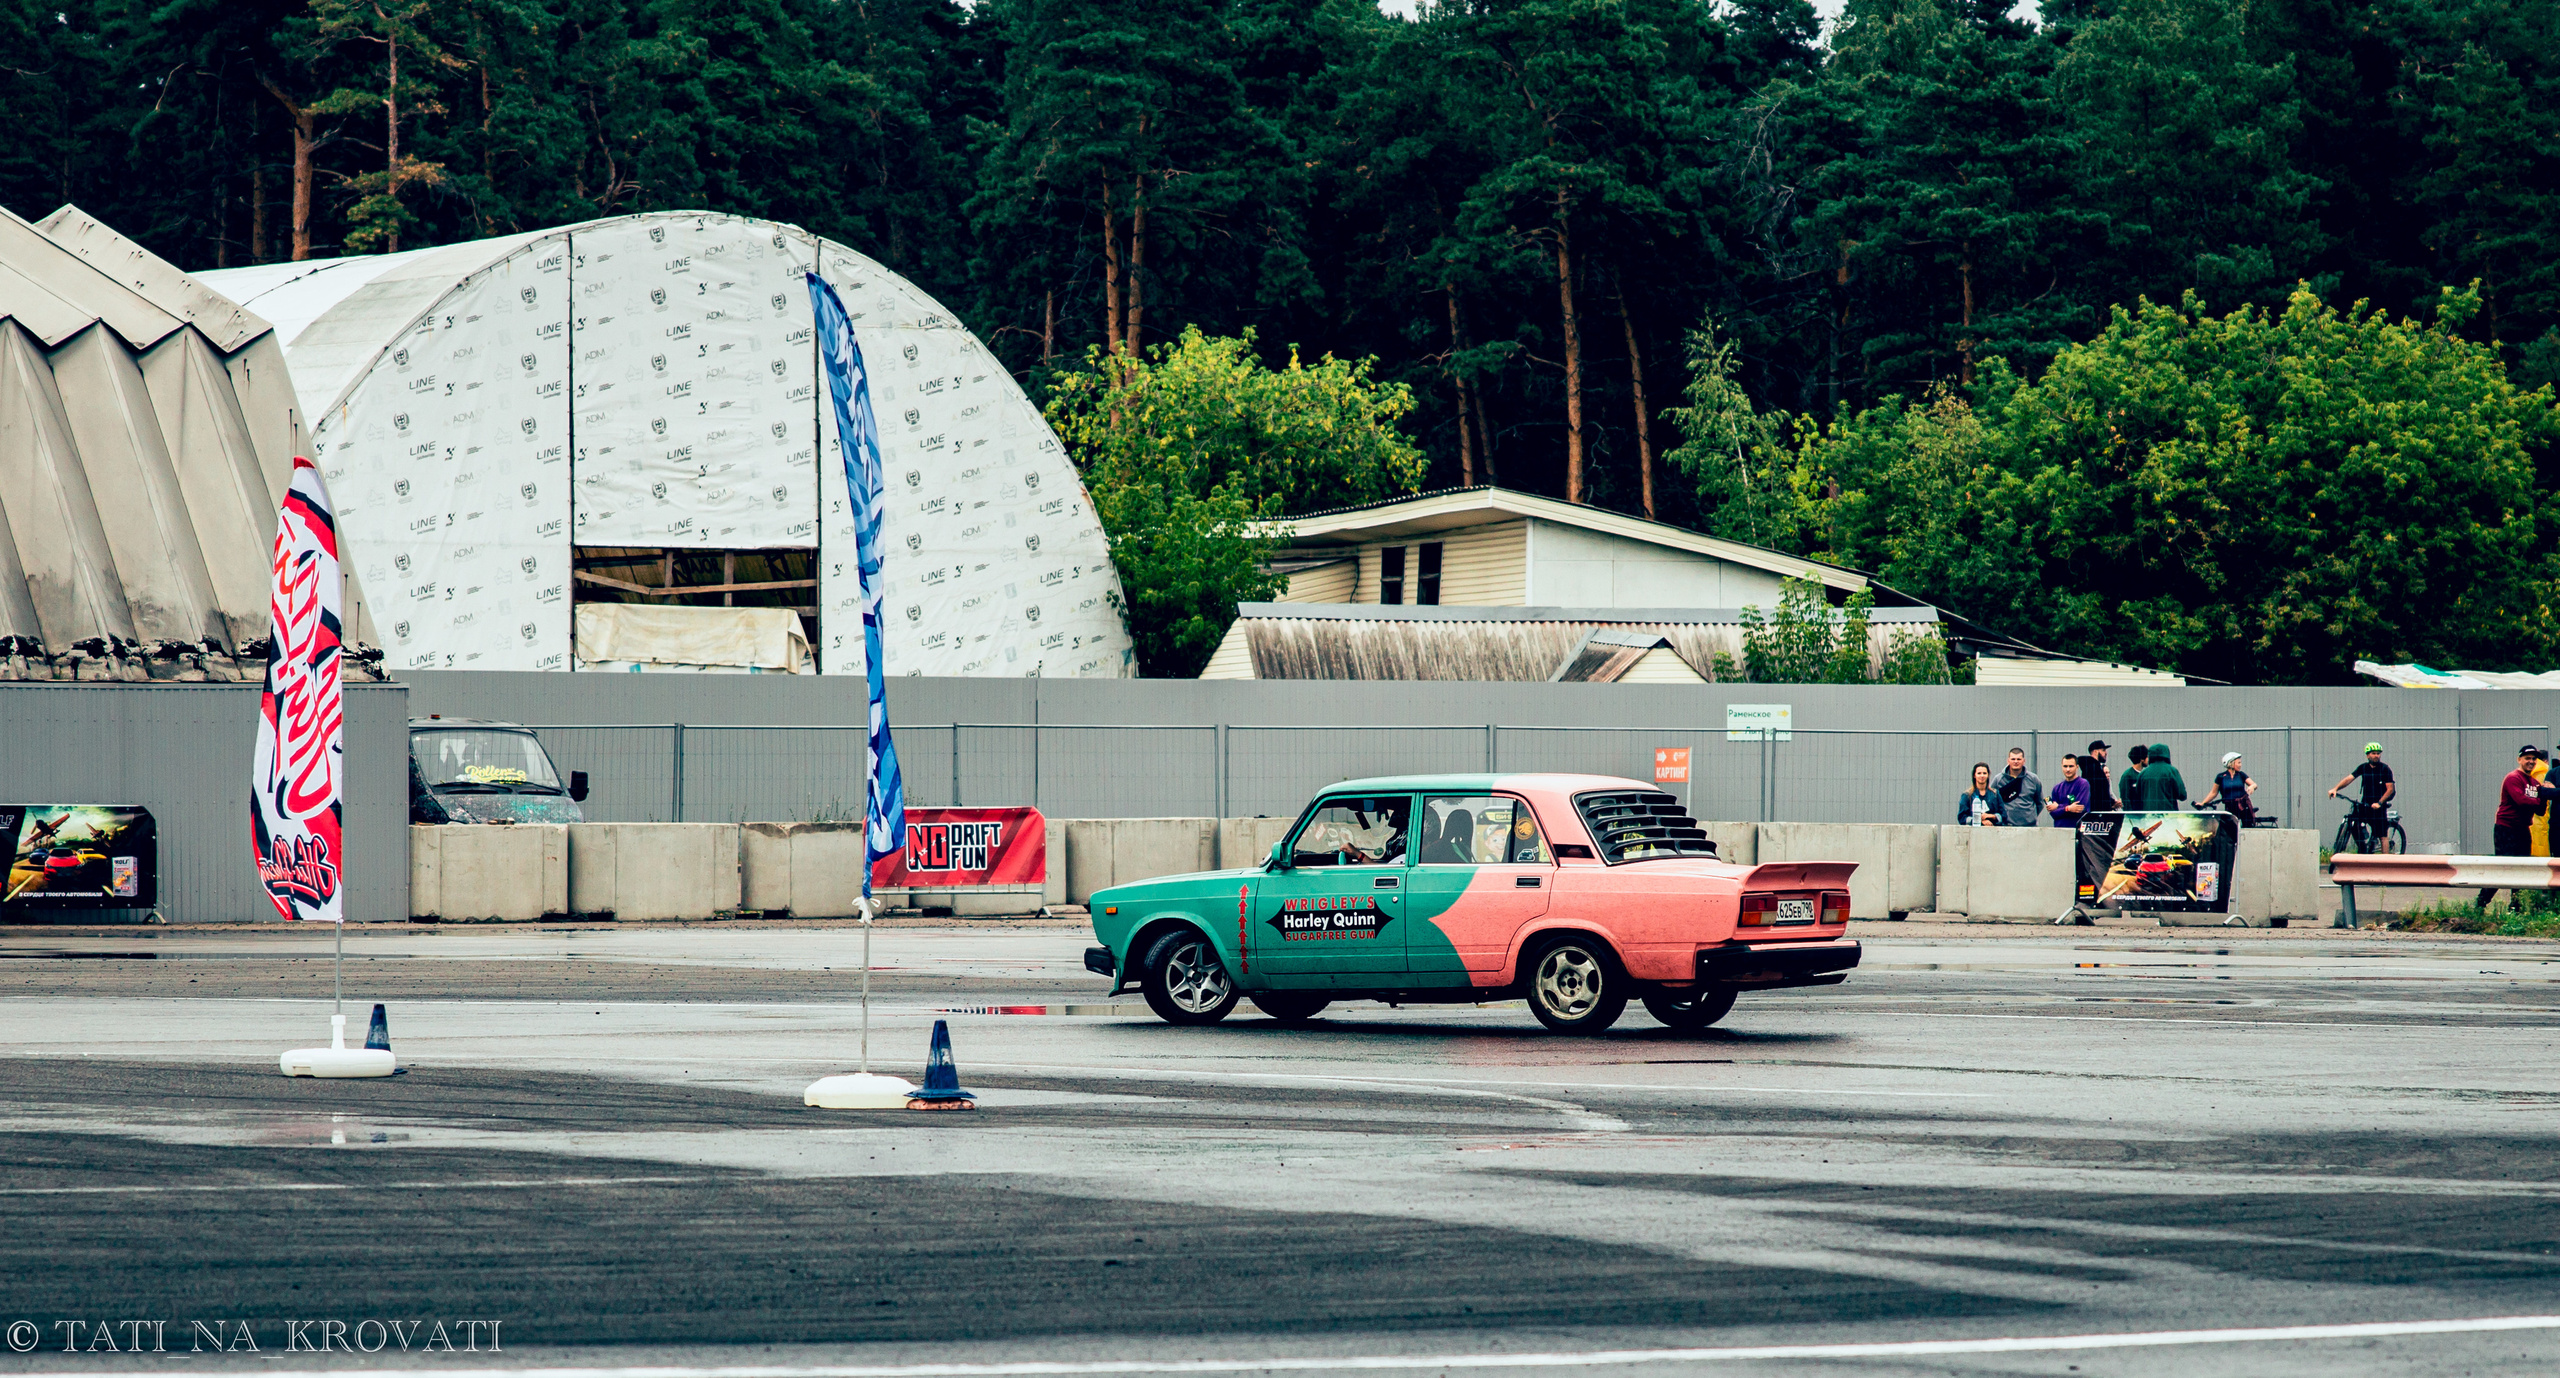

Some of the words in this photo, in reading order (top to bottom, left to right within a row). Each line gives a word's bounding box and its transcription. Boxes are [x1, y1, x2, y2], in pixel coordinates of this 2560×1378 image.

[537, 255, 562, 269] LINE
[666, 256, 690, 271] LINE
[787, 263, 811, 276] LINE
[536, 322, 562, 336] LINE
[666, 323, 691, 337] LINE
[786, 328, 811, 342] LINE
[409, 375, 435, 390] LINE
[536, 380, 561, 394] LINE
[667, 380, 692, 395] LINE
[919, 377, 944, 391] LINE
[786, 385, 810, 399] LINE
[920, 433, 945, 448] LINE
[410, 441, 436, 456] LINE
[537, 445, 561, 460] LINE
[667, 445, 692, 459] LINE
[787, 449, 811, 463] LINE
[921, 496, 945, 511] LINE
[1040, 498, 1063, 512] LINE
[410, 515, 436, 530] LINE
[537, 519, 561, 534] LINE
[668, 518, 692, 532] LINE
[787, 521, 811, 535] LINE
[921, 568, 945, 582] LINE
[1040, 569, 1064, 583] LINE
[411, 582, 436, 597] LINE
[536, 585, 562, 600] LINE
[922, 632, 946, 646] LINE
[1040, 632, 1064, 646] LINE
[410, 651, 435, 666] LINE
[536, 653, 561, 668] LINE
[1728, 709, 1771, 717] Раменское
[1656, 767, 1687, 779] КАРТИНГ
[952, 824, 1001, 846] DRIFT
[908, 825, 949, 869] NO
[952, 848, 987, 869] FUN
[1285, 896, 1375, 911] WRIGLEY'S
[1284, 913, 1329, 930] Harley
[1333, 912, 1376, 927] Quinn
[1286, 931, 1346, 941] SUGARFREE
[1350, 930, 1375, 939] GUM
